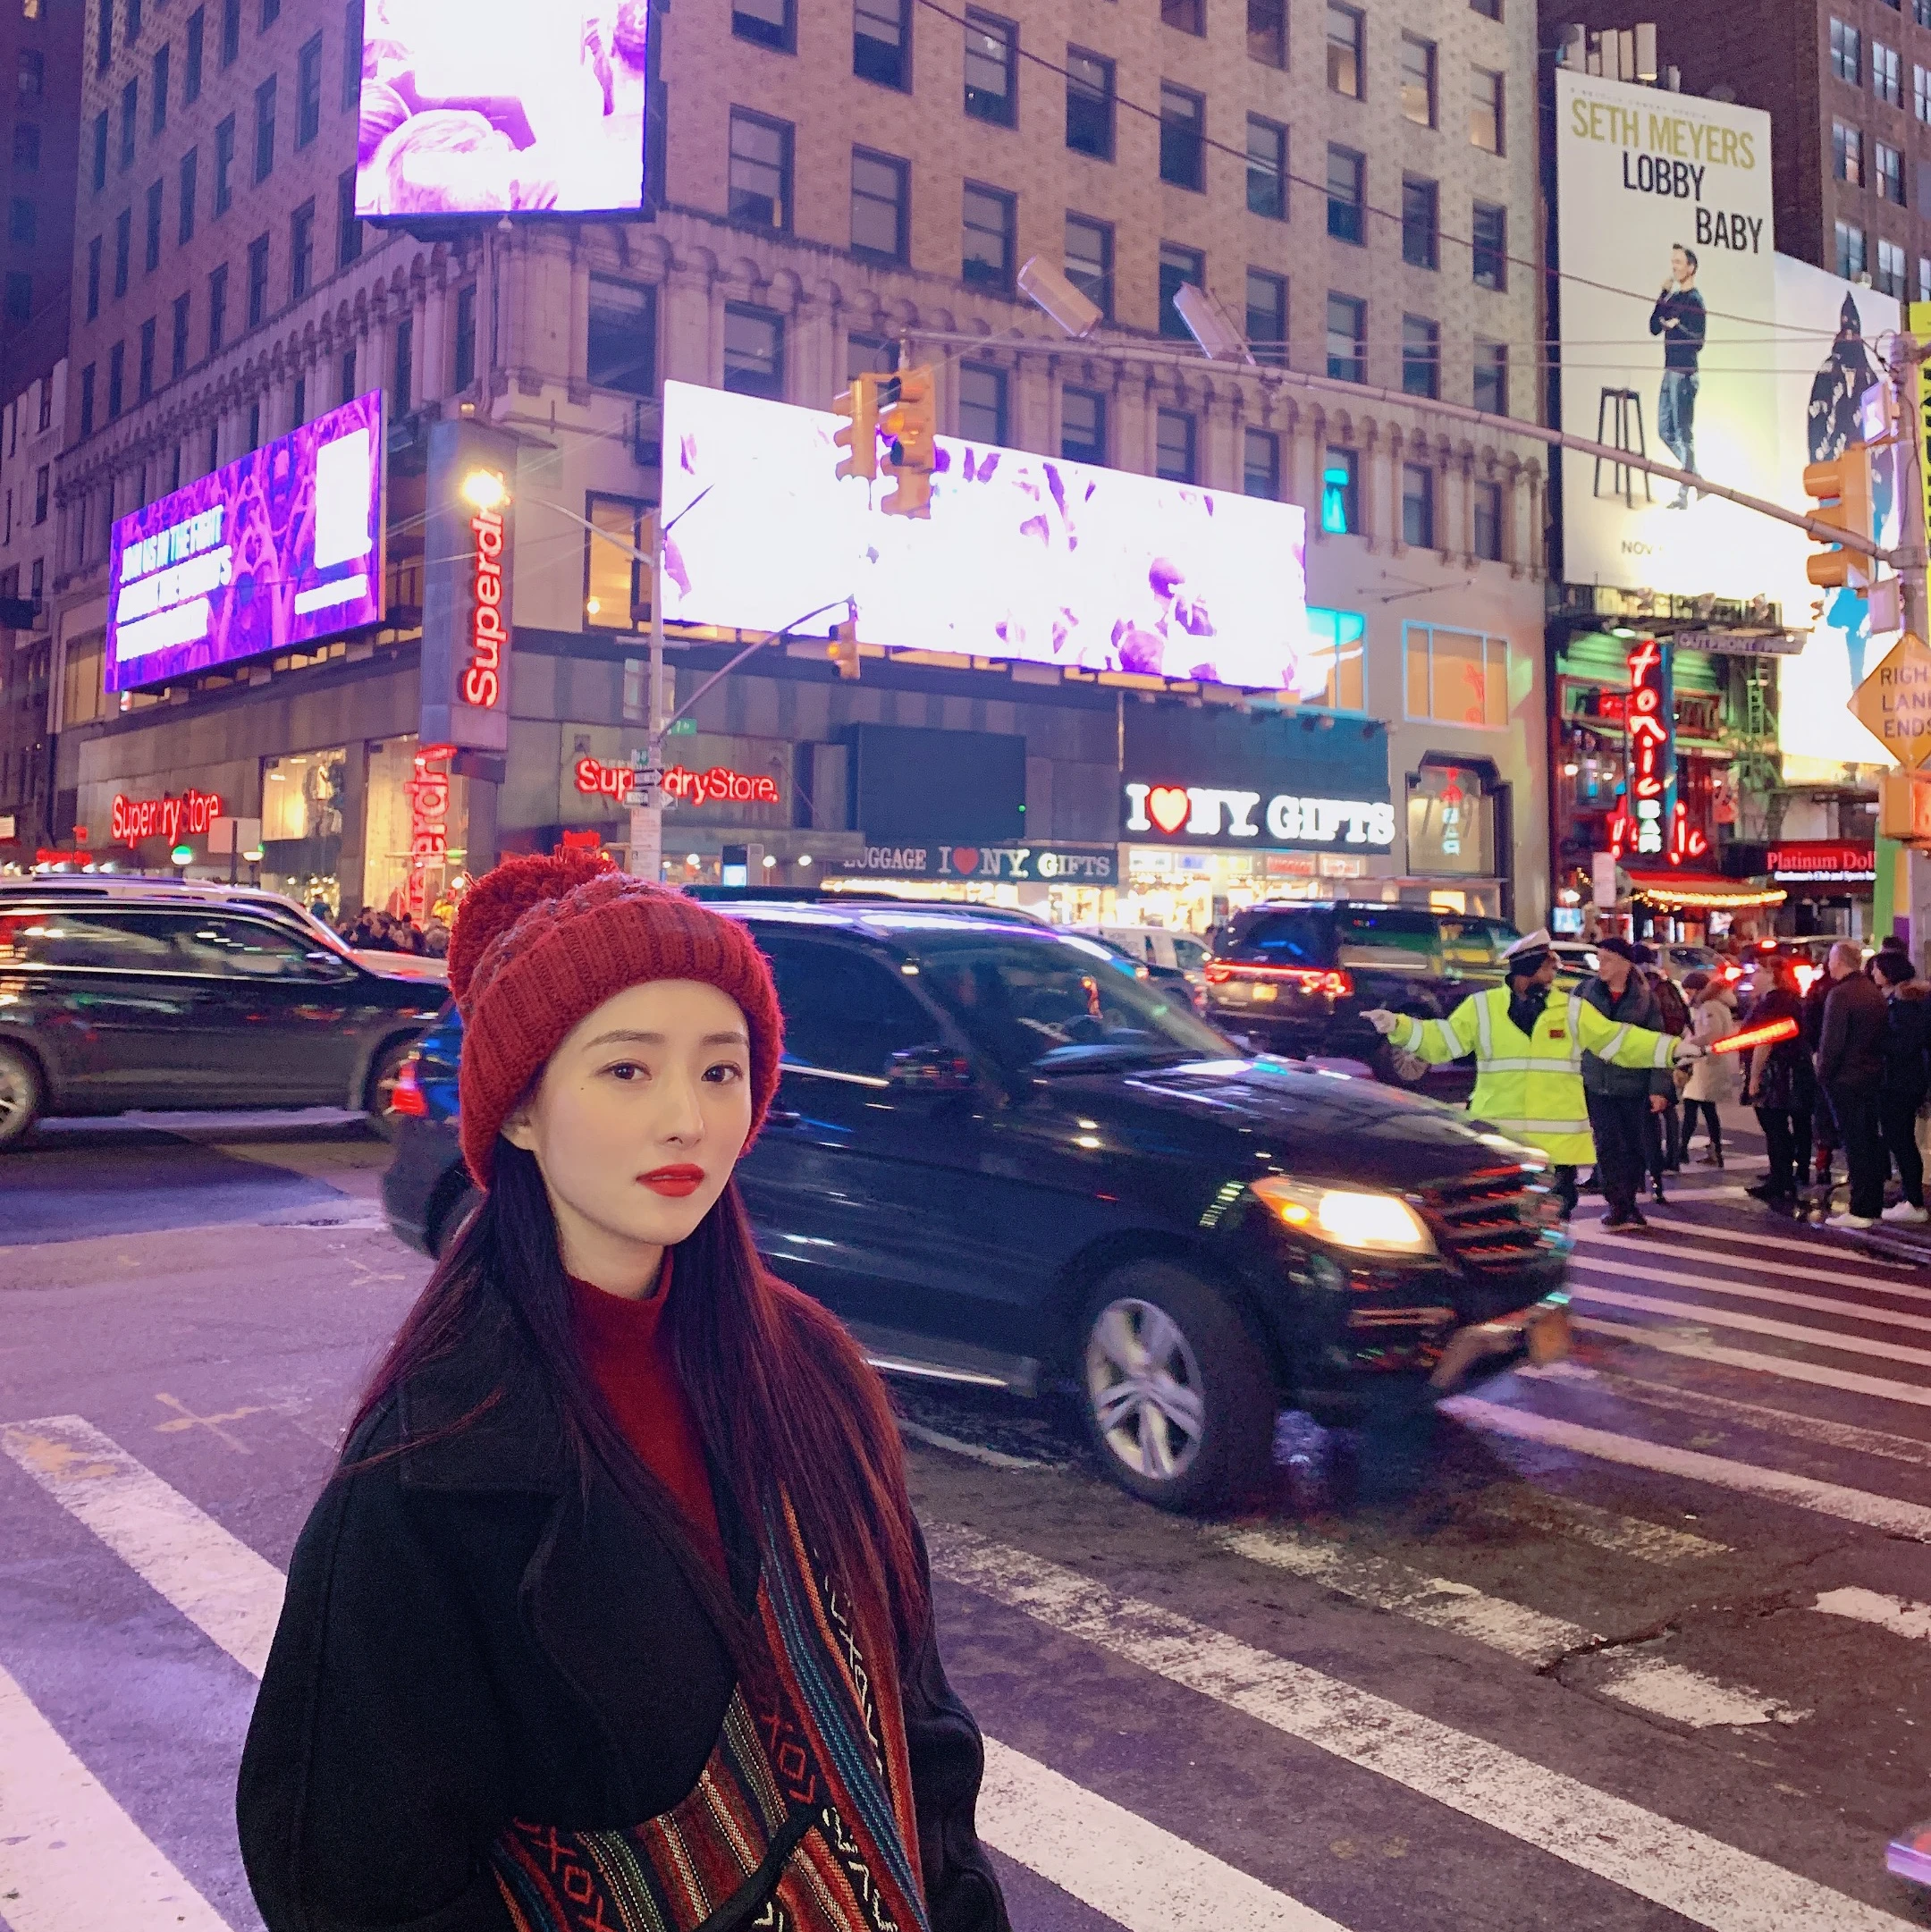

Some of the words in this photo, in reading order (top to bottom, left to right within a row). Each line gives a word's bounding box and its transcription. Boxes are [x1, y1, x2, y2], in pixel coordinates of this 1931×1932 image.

[1572, 97, 1640, 148] SETH
[1649, 113, 1756, 170] MEYERS
[1623, 150, 1706, 201] LOBBY
[1695, 206, 1763, 254] BABY
[1880, 664, 1931, 687] RIGH
[112, 794, 181, 850] Superry
[1267, 795, 1396, 845] GIFTS
[1037, 851, 1110, 878] GIFTS
[1767, 851, 1838, 870] Platinum
